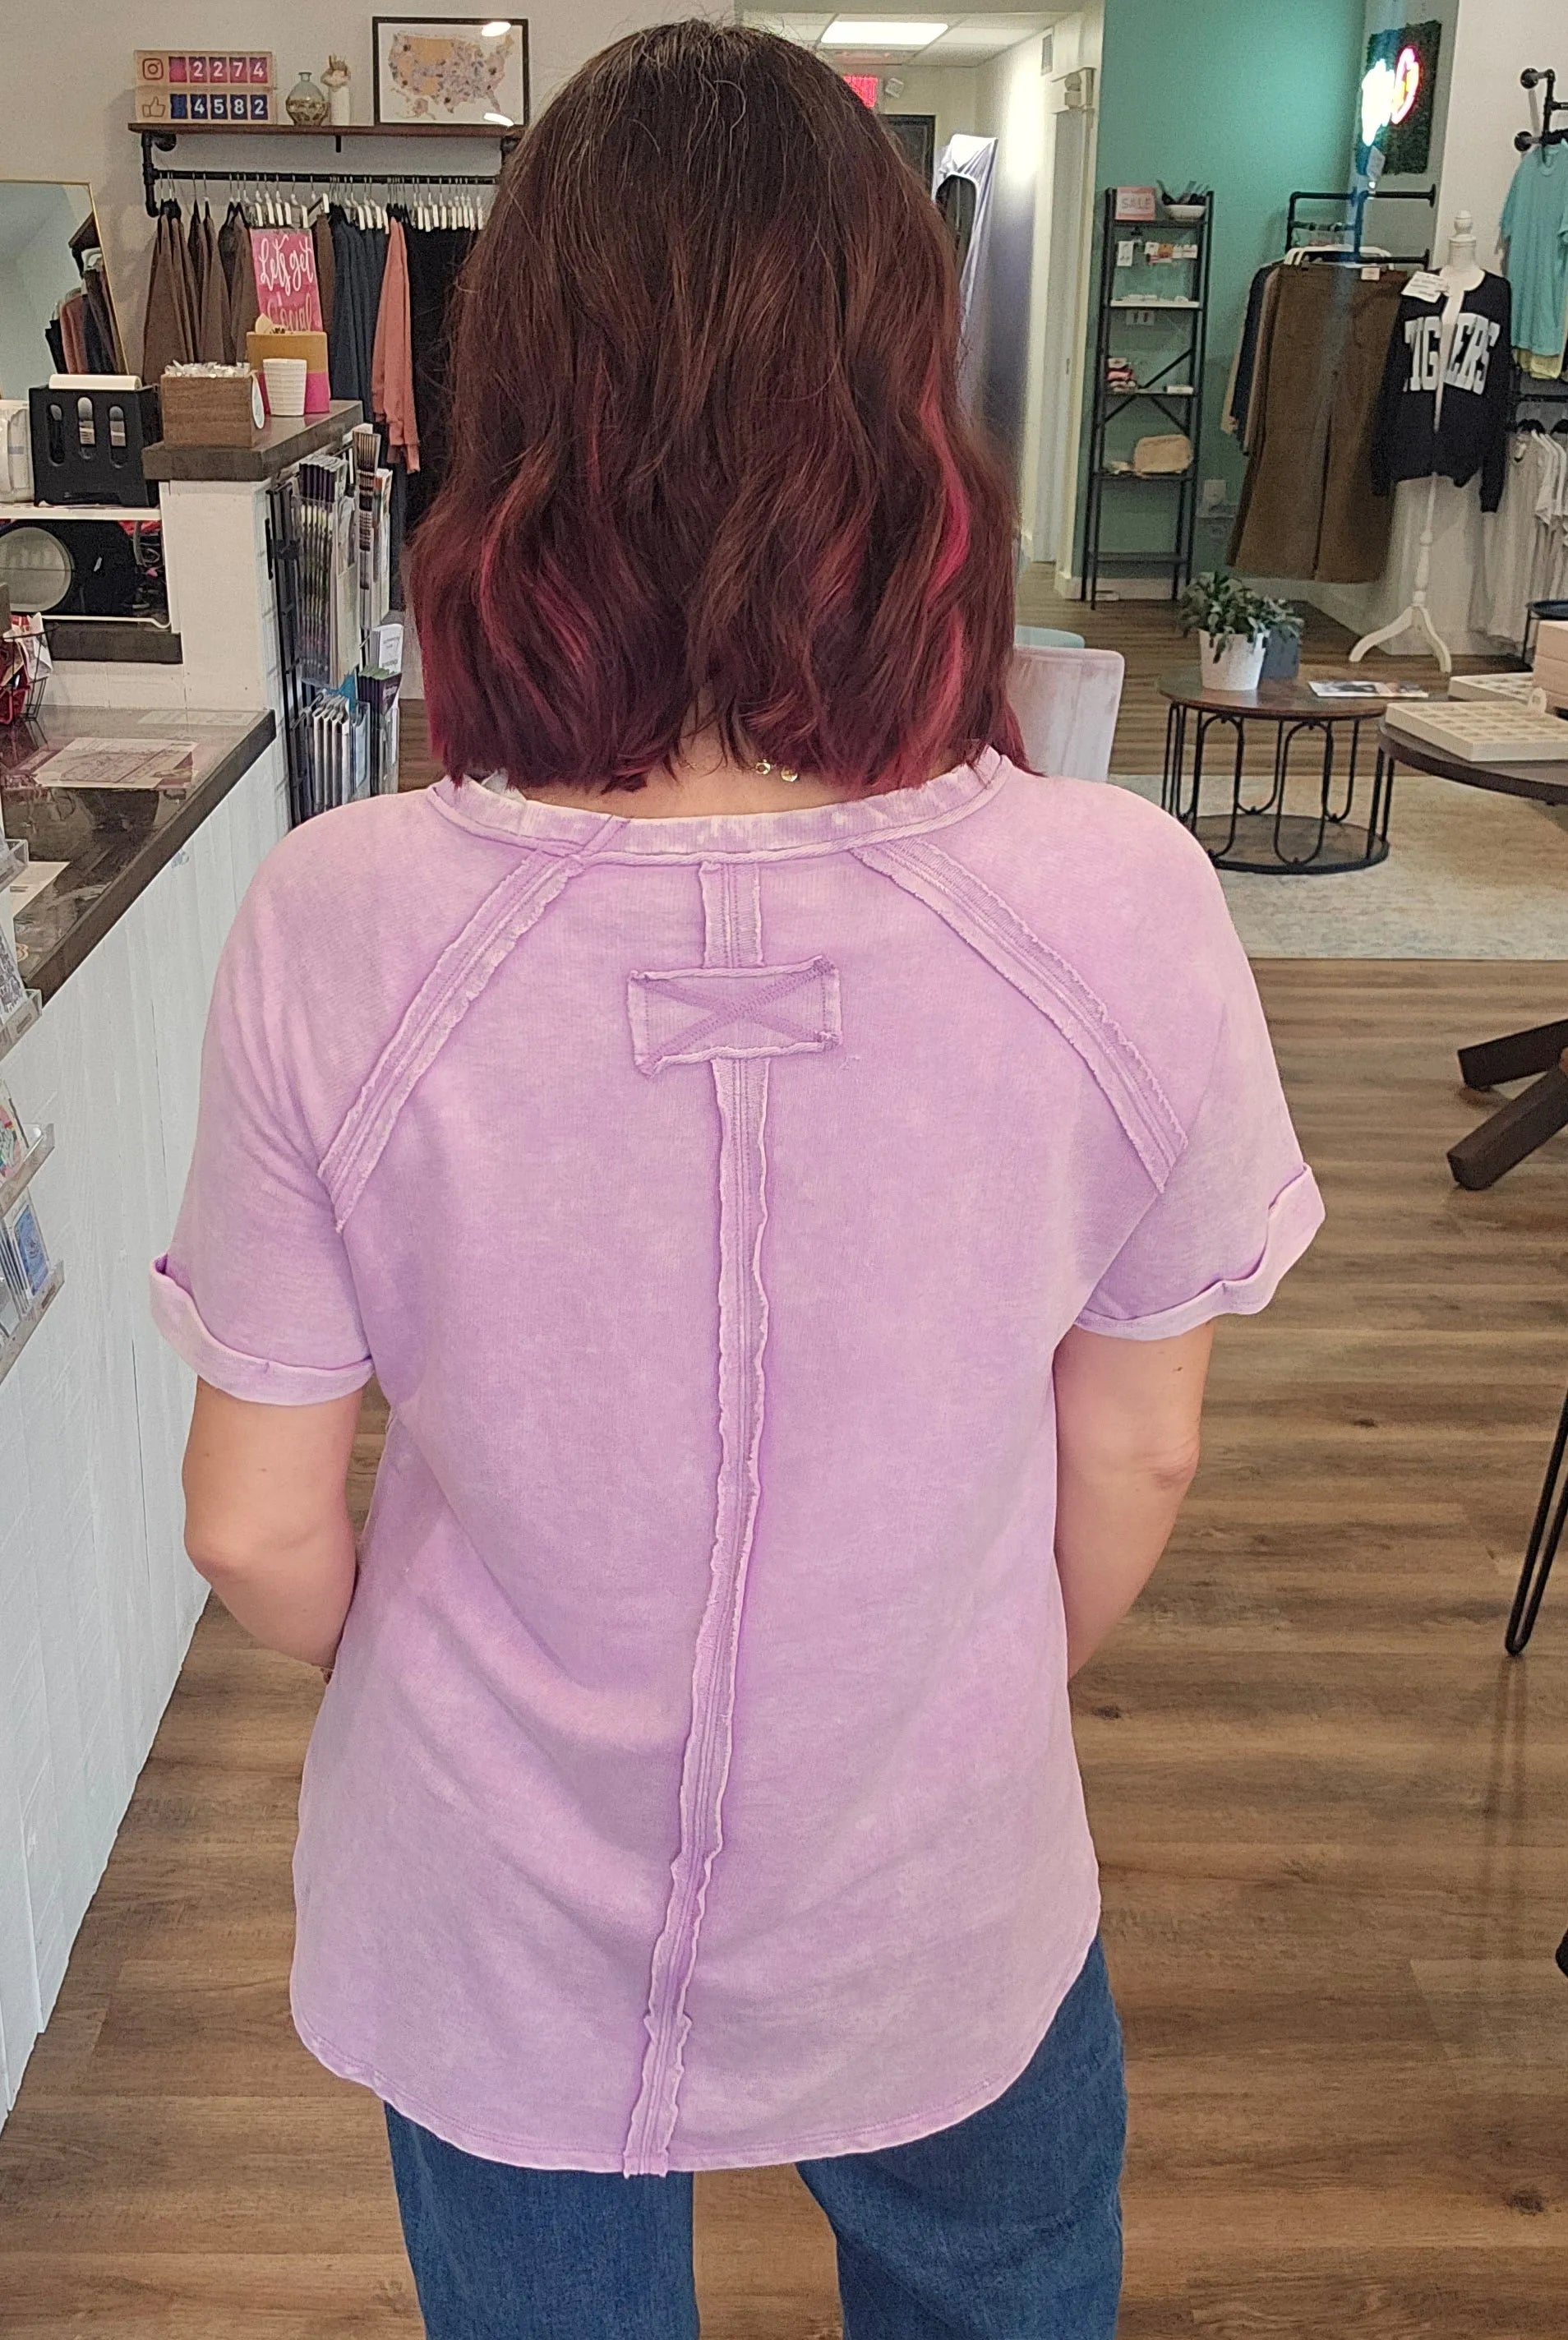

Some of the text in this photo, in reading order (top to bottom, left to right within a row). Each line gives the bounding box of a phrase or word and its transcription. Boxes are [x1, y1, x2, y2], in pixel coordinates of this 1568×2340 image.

[192, 60, 265, 78] 2274
[193, 98, 265, 115] 4582
[1121, 196, 1152, 210] SALE
[289, 237, 313, 292] get
